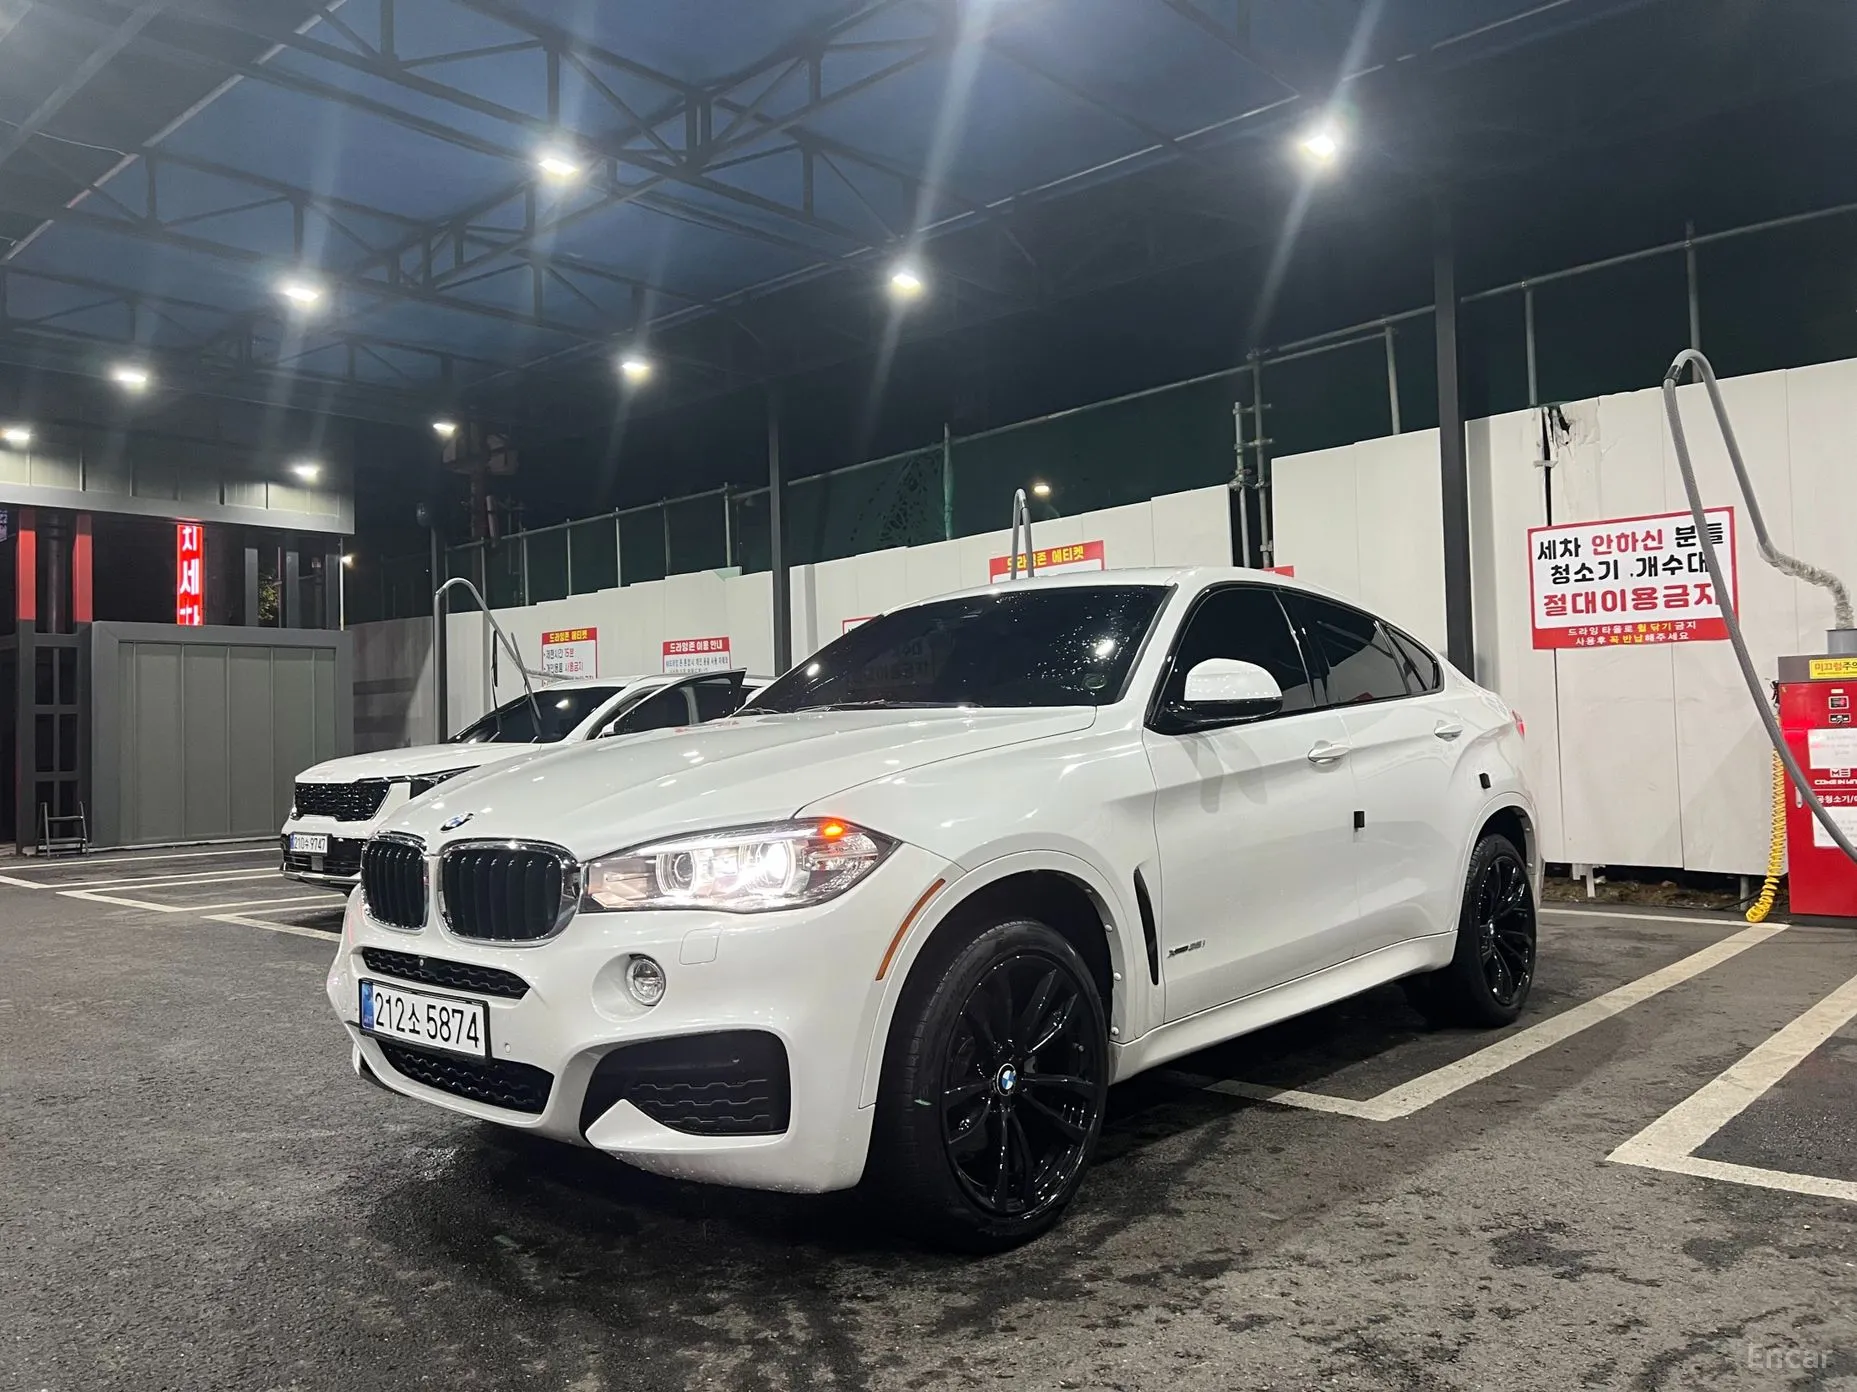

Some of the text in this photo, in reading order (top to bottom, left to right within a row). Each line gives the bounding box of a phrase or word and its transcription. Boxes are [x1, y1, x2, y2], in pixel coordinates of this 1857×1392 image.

[1538, 537, 1581, 560] 세차
[1591, 529, 1664, 556] 안하신
[1007, 546, 1084, 571] 드라존 에티켓
[1550, 559, 1619, 585] 청소기
[1544, 583, 1721, 617] 절대이용금지
[1568, 626, 1599, 636] 드라잉
[1675, 620, 1696, 631] 금지
[1576, 635, 1607, 646] 사용후
[669, 641, 696, 653] 드라잉존
[375, 992, 480, 1048] 212소 5874
